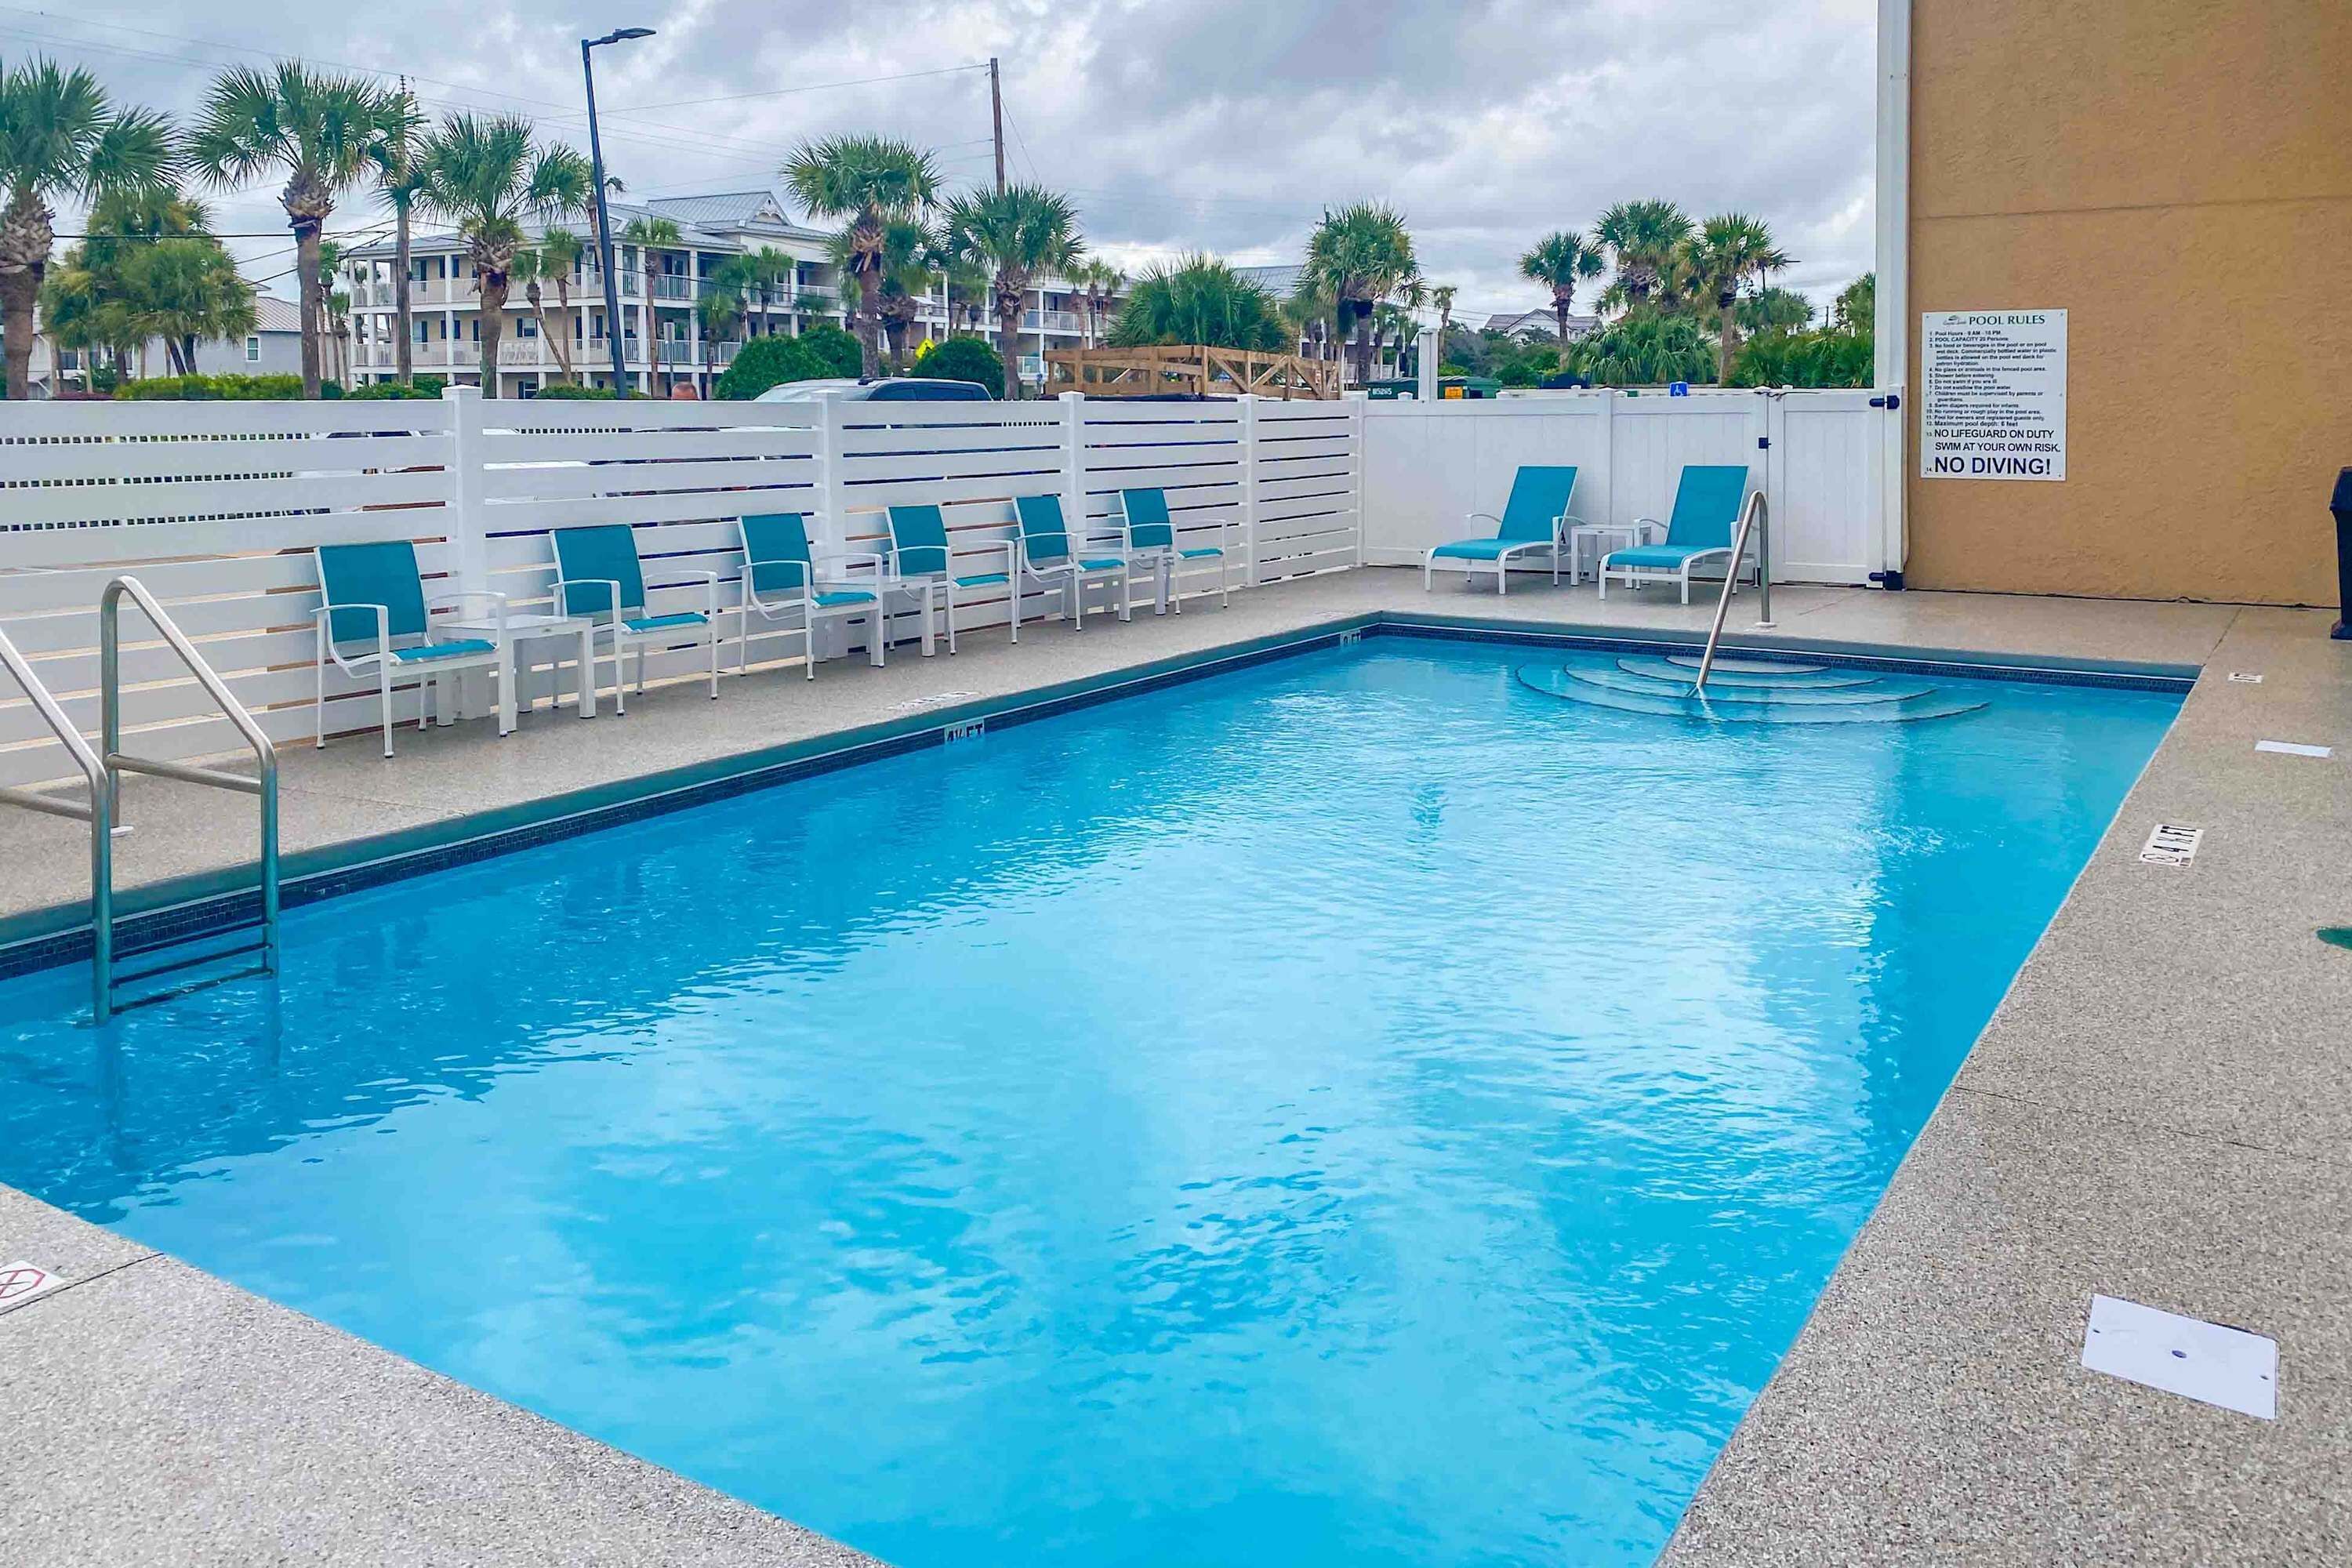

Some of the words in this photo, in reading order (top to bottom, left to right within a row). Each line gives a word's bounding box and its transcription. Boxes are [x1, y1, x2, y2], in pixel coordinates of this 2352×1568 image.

[1969, 315, 2002, 325] POOL
[2008, 315, 2045, 325] RULES
[2009, 430, 2024, 438] ON
[2027, 430, 2054, 438] DUTY
[1963, 442, 1976, 451] AT
[2008, 443, 2032, 452] OWN
[2034, 443, 2060, 452] RISK.
[1935, 457, 1965, 473] NO
[1973, 458, 2051, 475] DIVING!
[967, 724, 983, 737] FT
